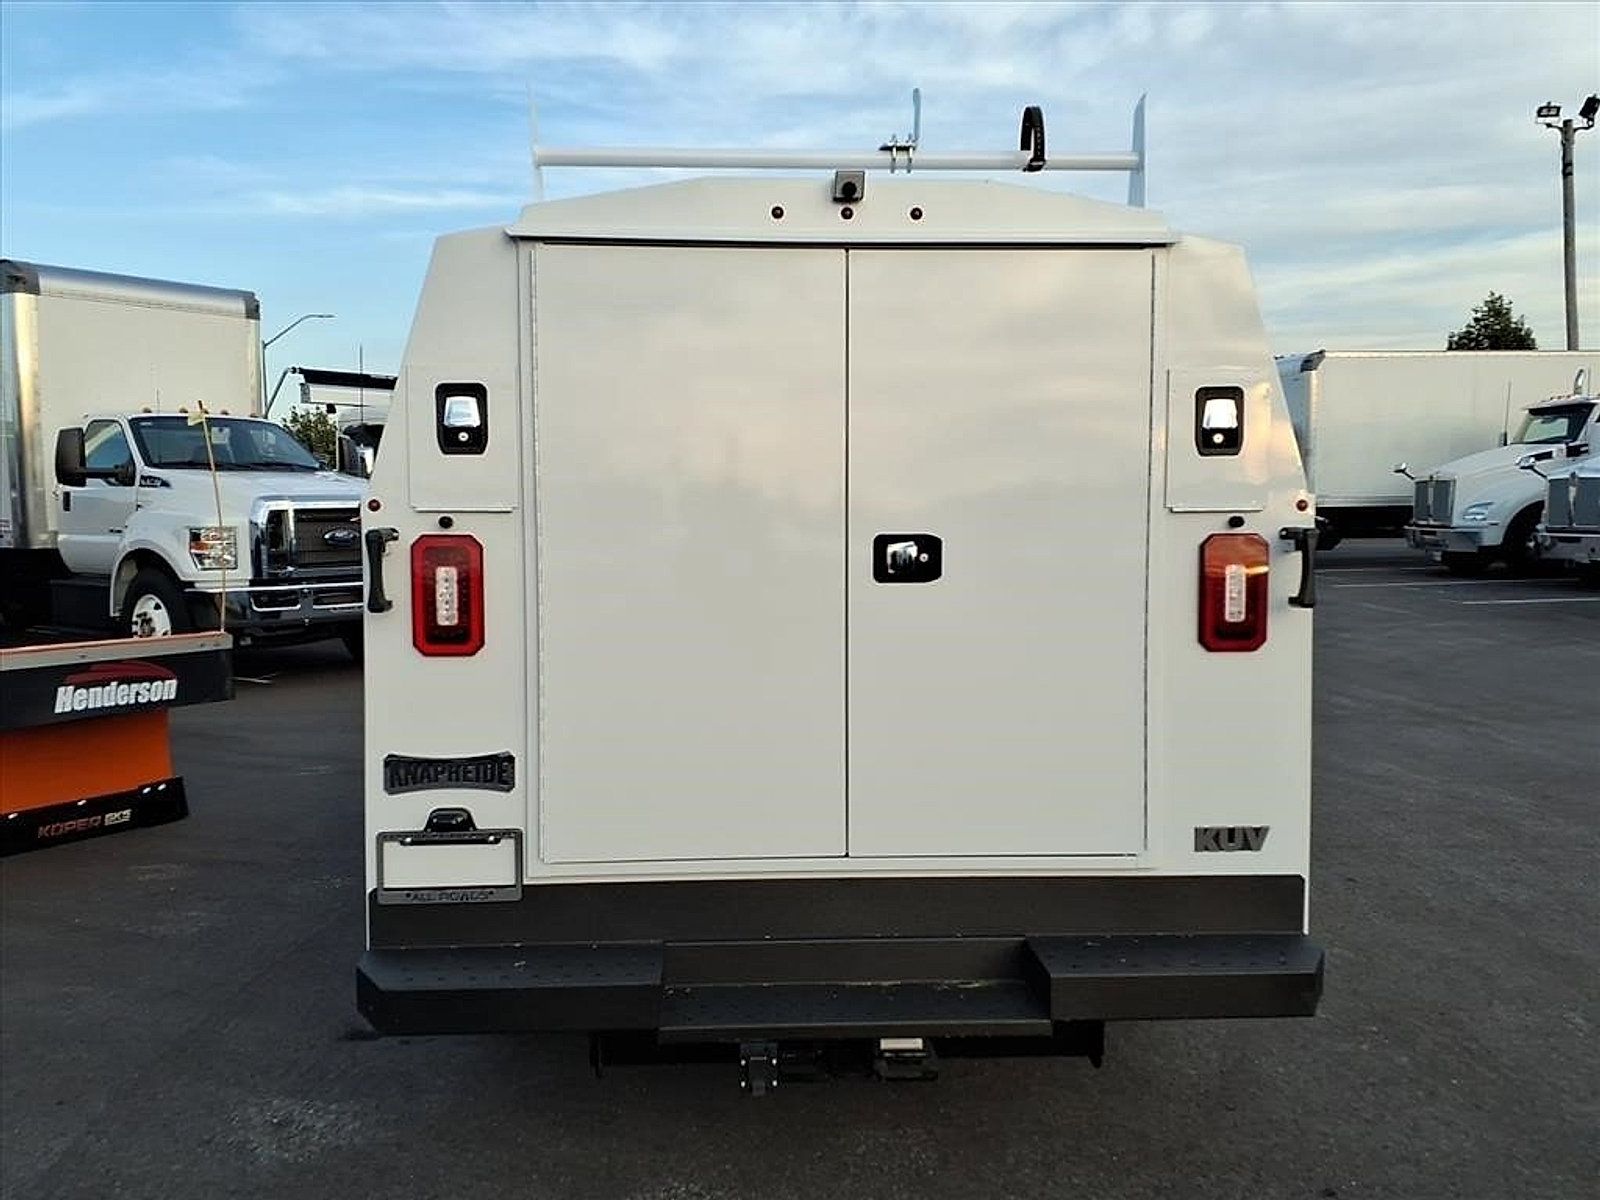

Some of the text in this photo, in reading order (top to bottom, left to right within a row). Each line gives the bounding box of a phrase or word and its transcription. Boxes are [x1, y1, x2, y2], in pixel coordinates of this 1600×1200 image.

[54, 679, 178, 714] Henderson
[387, 757, 513, 788] KNAPHEIDE
[1194, 826, 1270, 852] KUV
